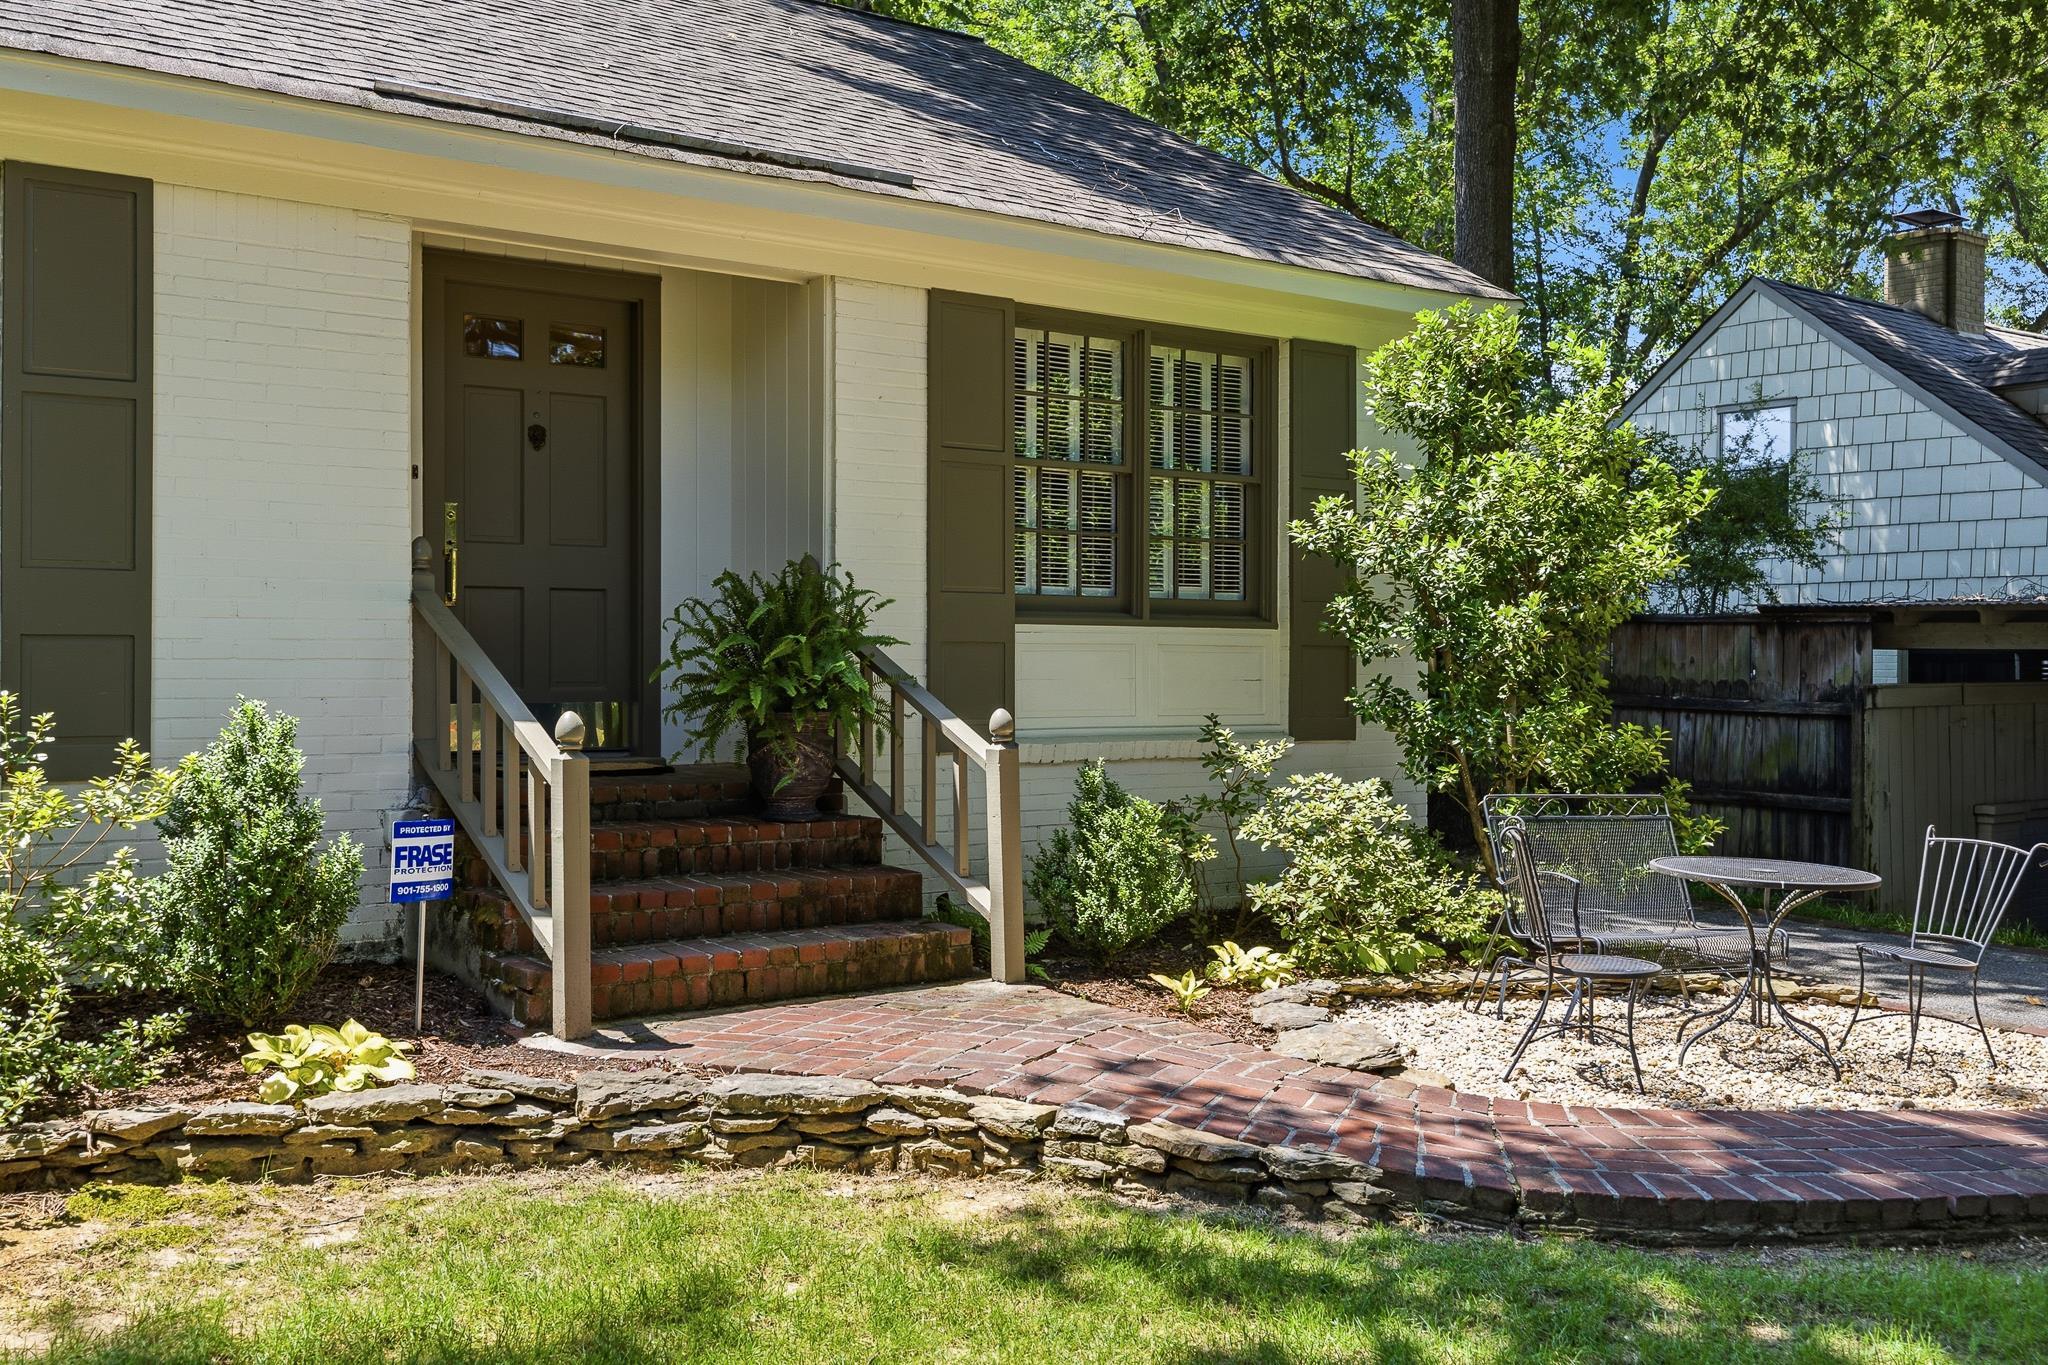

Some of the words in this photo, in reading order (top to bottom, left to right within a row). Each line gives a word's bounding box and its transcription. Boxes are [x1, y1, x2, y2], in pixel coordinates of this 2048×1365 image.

[400, 825, 441, 834] PROTECTED
[394, 843, 452, 868] FRASE
[394, 865, 452, 875] PROTECTION
